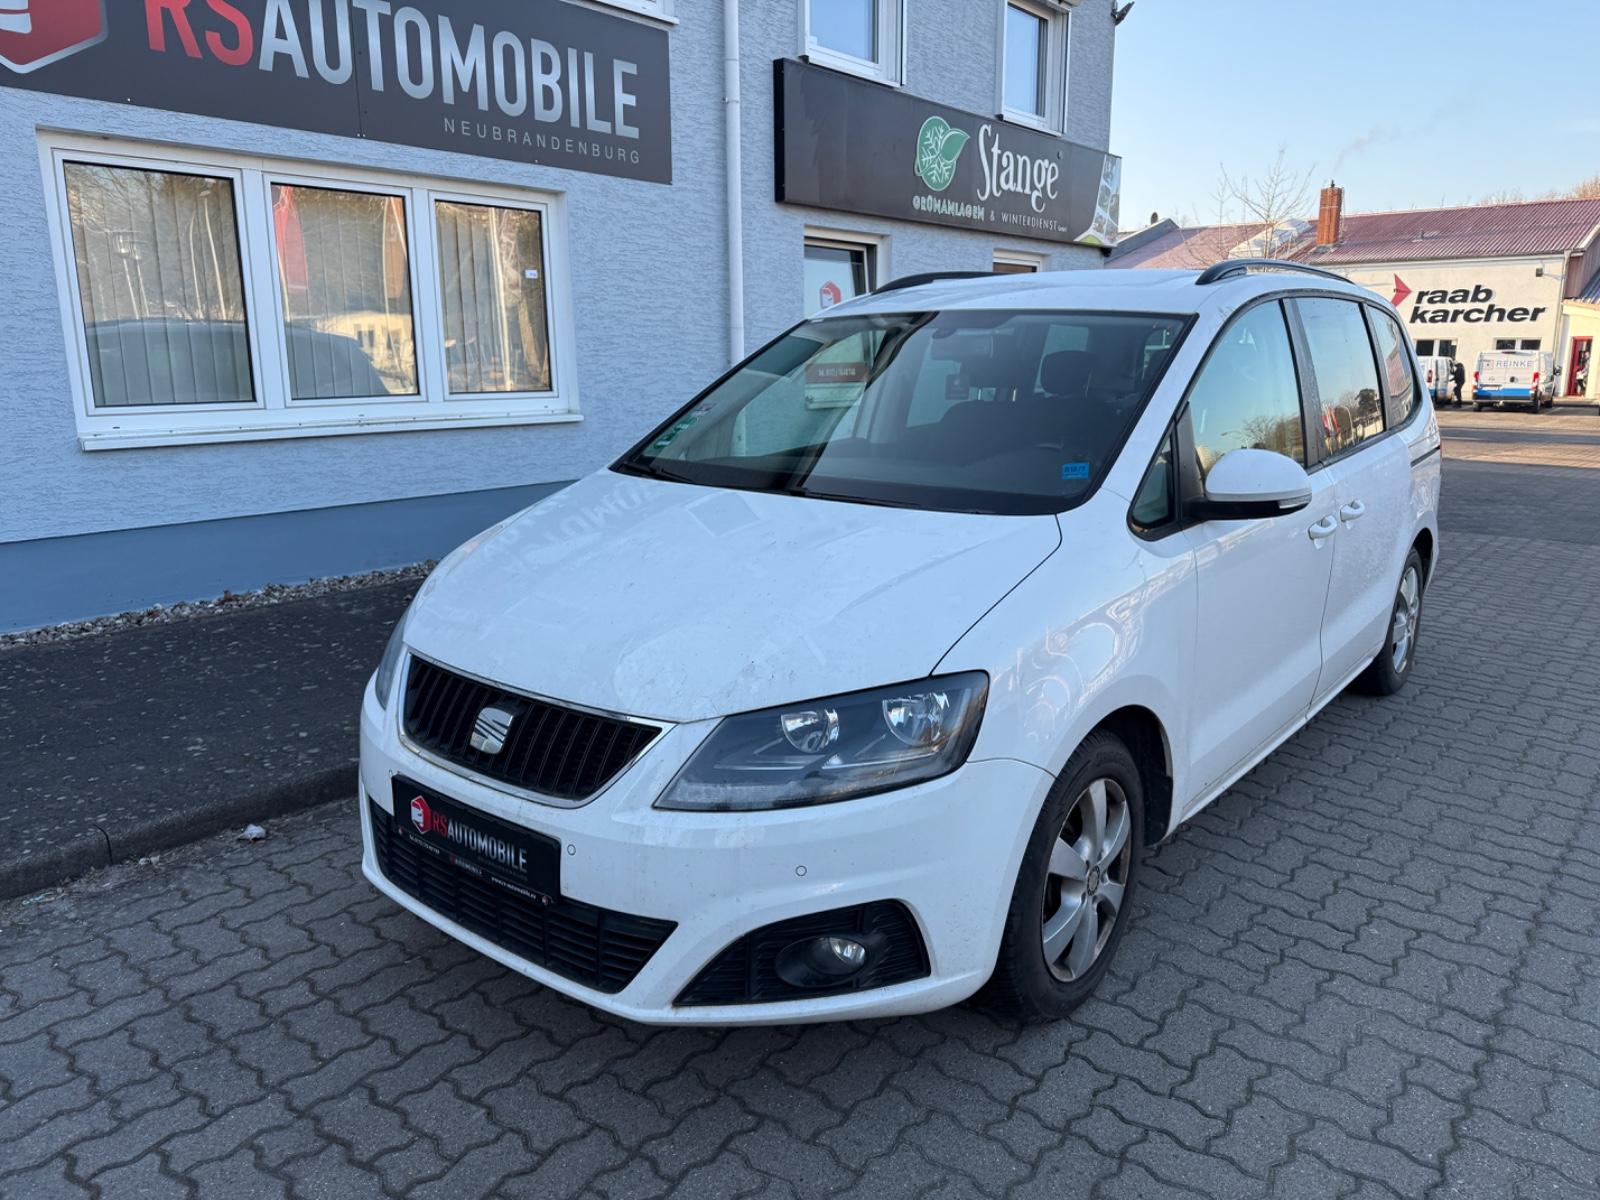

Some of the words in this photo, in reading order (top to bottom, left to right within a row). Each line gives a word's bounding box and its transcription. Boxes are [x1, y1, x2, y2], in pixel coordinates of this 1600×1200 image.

[443, 117, 641, 164] NEUBRANDENBURG
[976, 123, 1060, 213] Stange
[1001, 212, 1058, 231] WINTERDIENST
[1414, 284, 1494, 305] raab
[1409, 304, 1547, 324] karcher
[1496, 360, 1534, 368] REINKE
